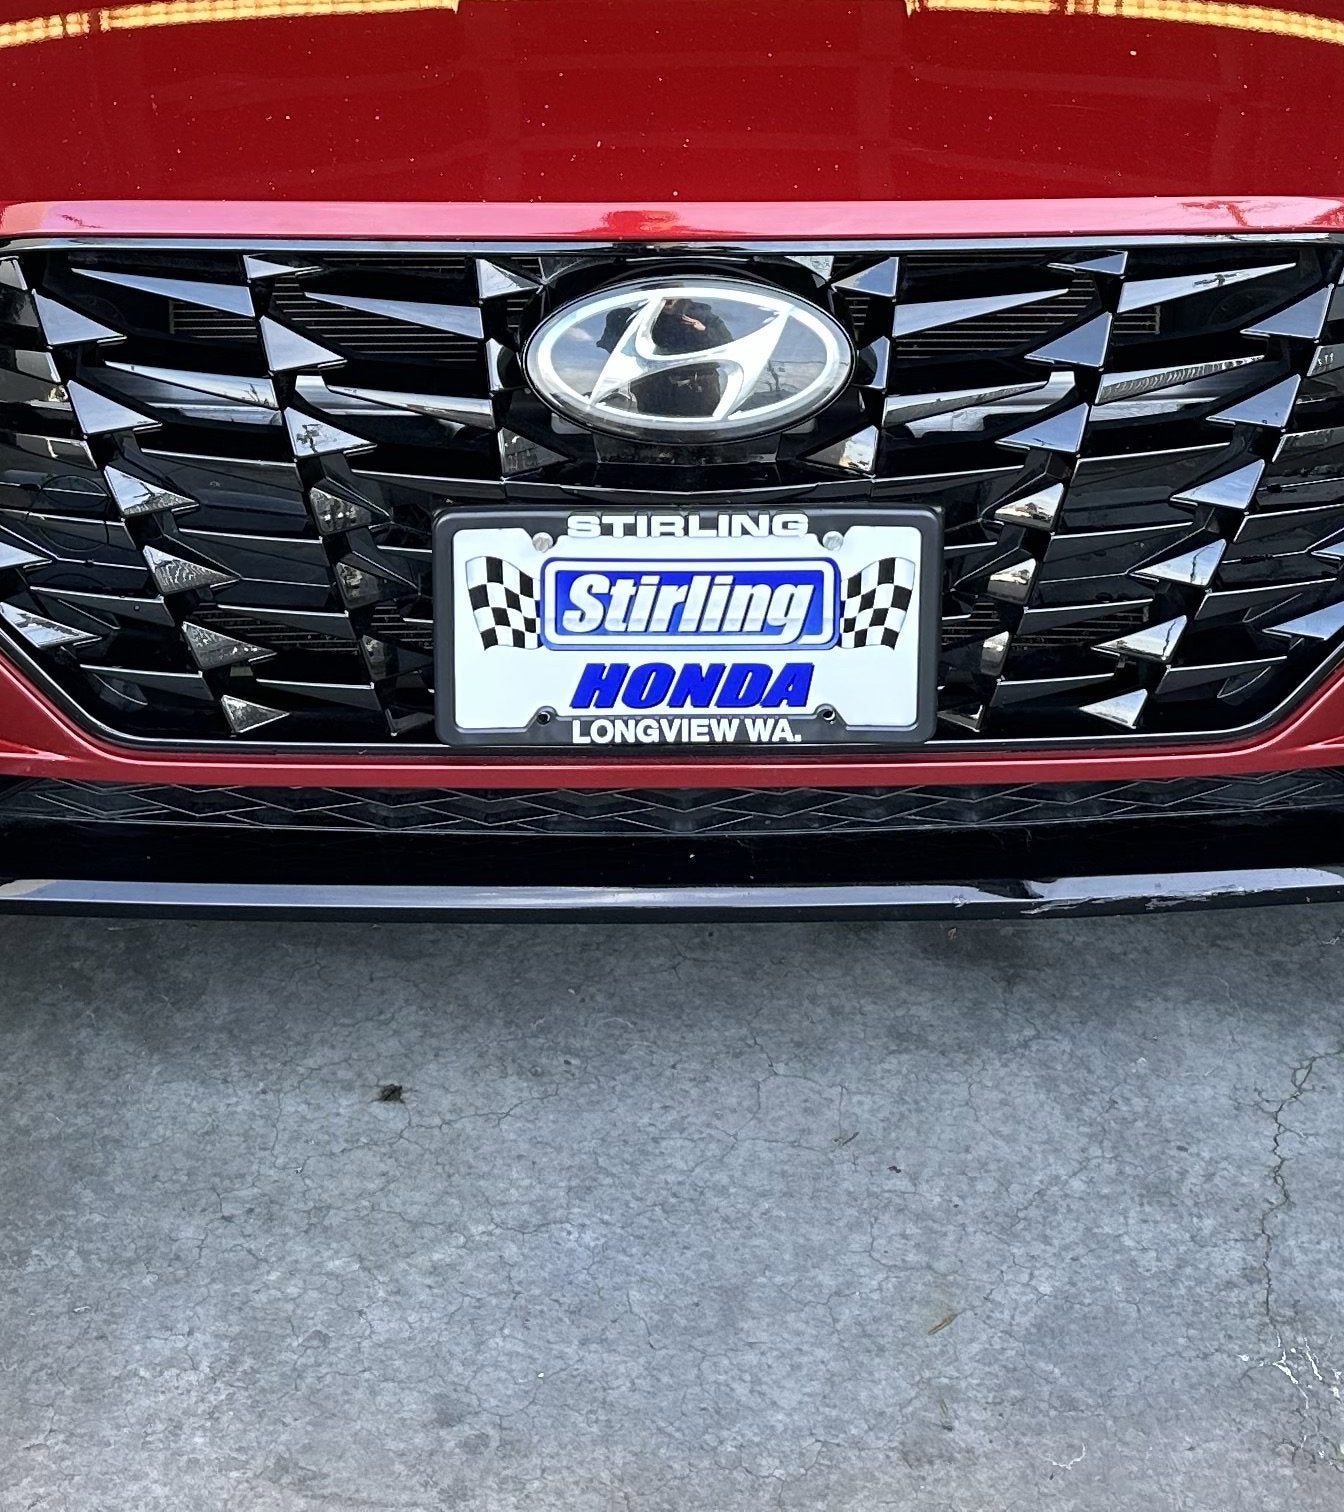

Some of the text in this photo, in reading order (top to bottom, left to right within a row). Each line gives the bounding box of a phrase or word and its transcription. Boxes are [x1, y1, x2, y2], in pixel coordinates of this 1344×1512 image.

[566, 512, 810, 538] STIRLING
[561, 573, 816, 645] Stirling
[570, 661, 816, 710] HONDA
[571, 718, 803, 745] LONGVIEW WA.
